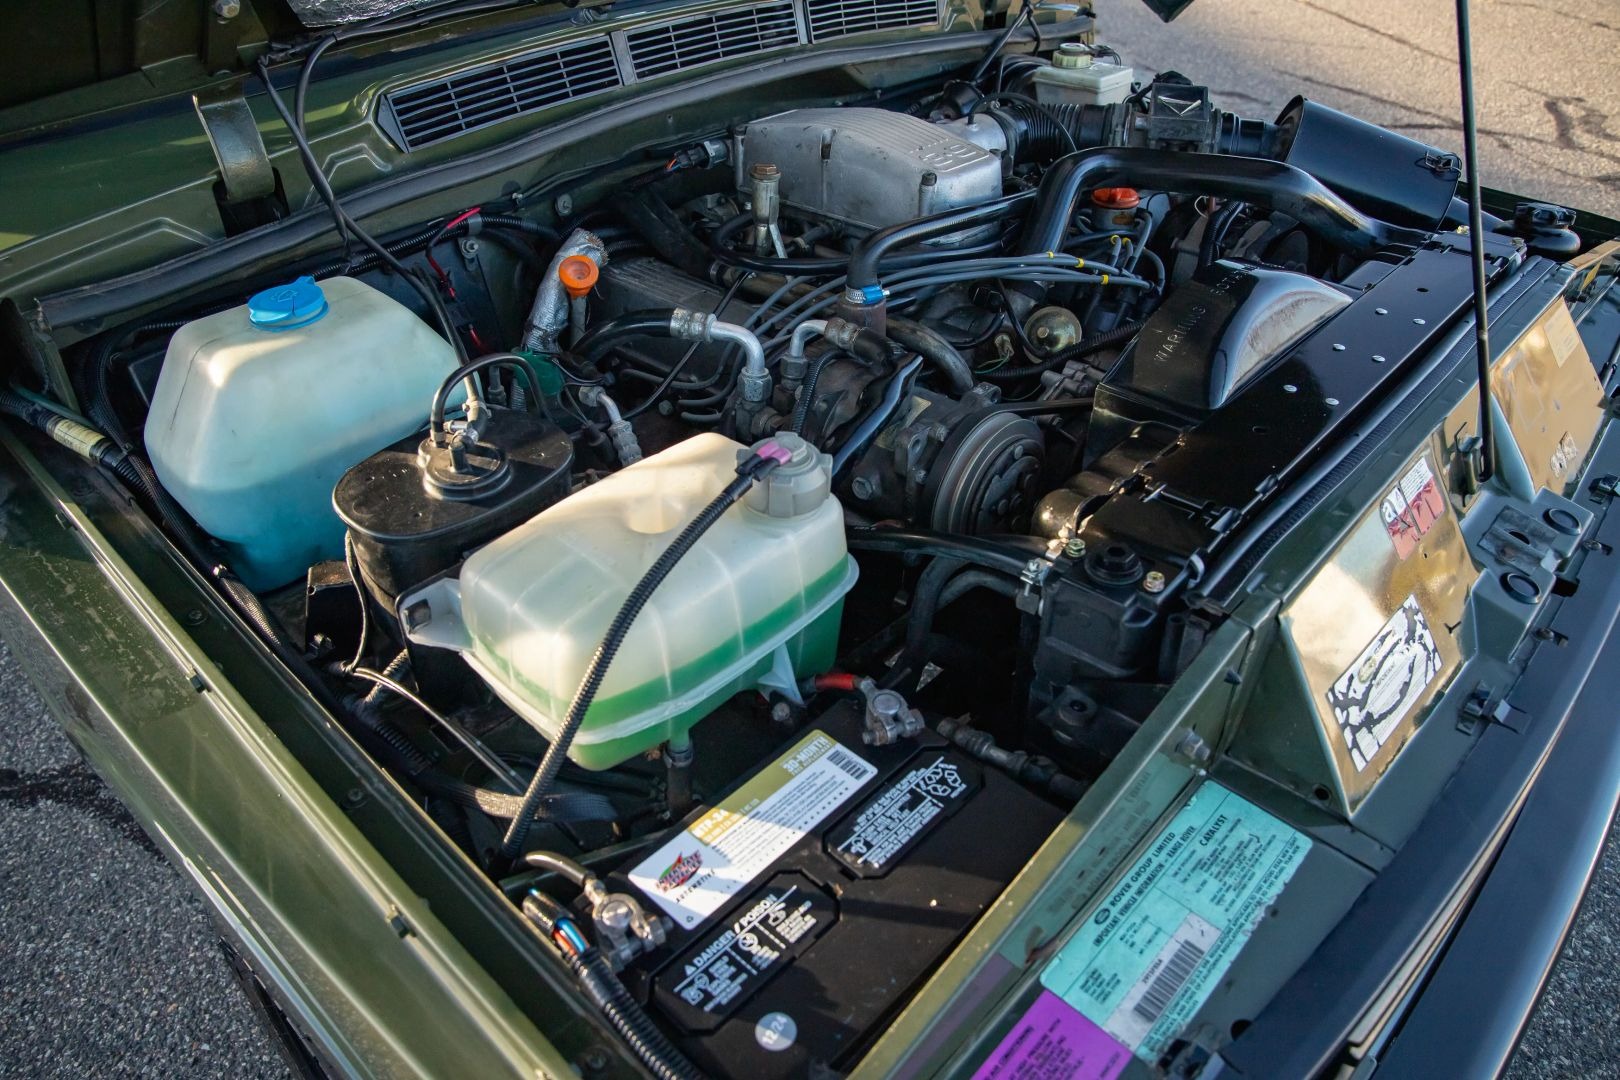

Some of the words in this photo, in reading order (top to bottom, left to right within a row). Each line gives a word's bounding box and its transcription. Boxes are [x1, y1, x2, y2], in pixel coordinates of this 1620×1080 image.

[1198, 813, 1228, 847] CATALYST
[1093, 915, 1121, 947] IMPORTANT
[1118, 895, 1138, 917] VEHICLE
[1134, 861, 1165, 897] INFORMATION
[1166, 840, 1183, 858] RANGE
[1179, 825, 1196, 842] ROVER
[1108, 881, 1133, 908] ROVER
[1129, 856, 1154, 883] GROUP
[1151, 830, 1176, 858] LIMITED
[691, 928, 736, 967] DANGER
[739, 892, 777, 926] POISON
[762, 1016, 788, 1044] 12/24
